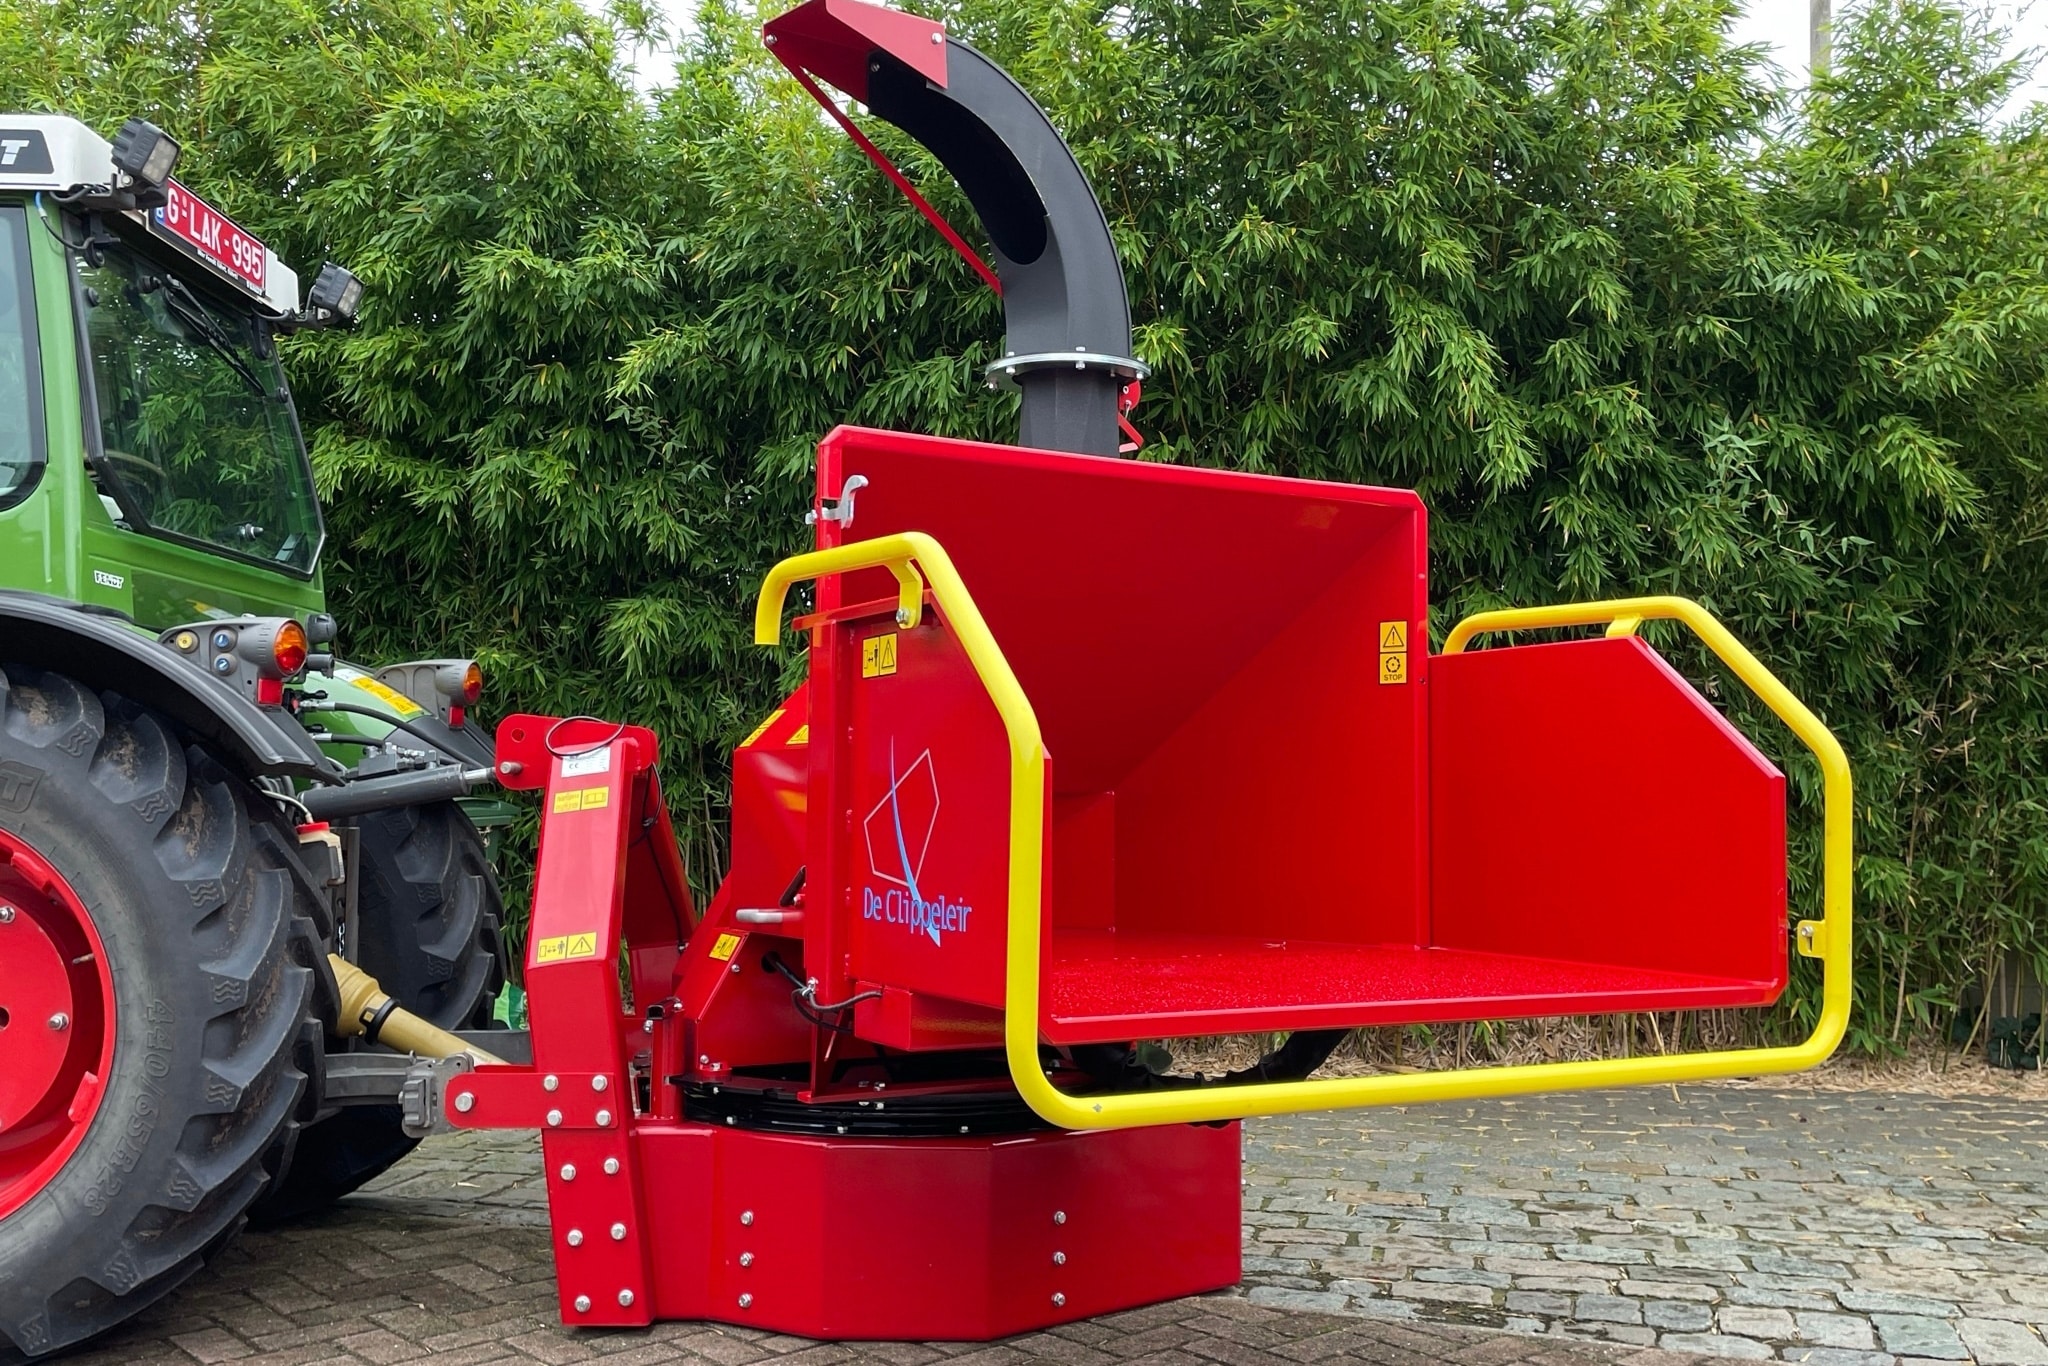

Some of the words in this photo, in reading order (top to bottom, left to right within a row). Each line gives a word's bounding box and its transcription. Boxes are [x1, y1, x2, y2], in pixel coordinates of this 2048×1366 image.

[94, 570, 124, 589] FENDT
[863, 886, 883, 921] De
[885, 888, 973, 936] Clippeleir
